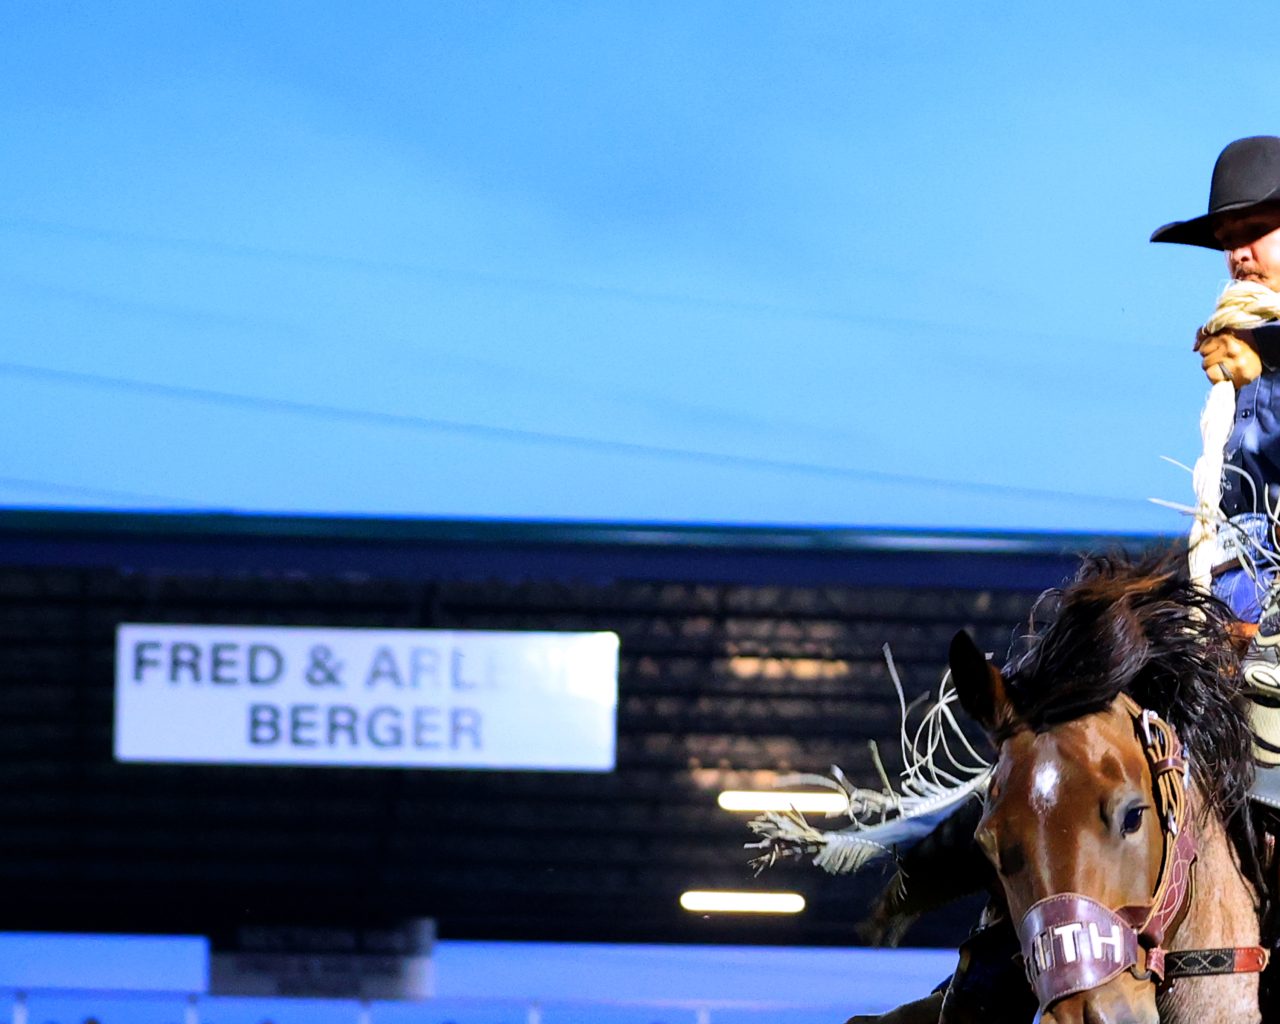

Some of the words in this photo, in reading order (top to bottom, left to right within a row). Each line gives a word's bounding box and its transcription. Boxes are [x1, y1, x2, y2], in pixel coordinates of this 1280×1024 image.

[131, 641, 286, 686] FRED
[304, 645, 344, 688] &
[248, 704, 484, 750] BERGER
